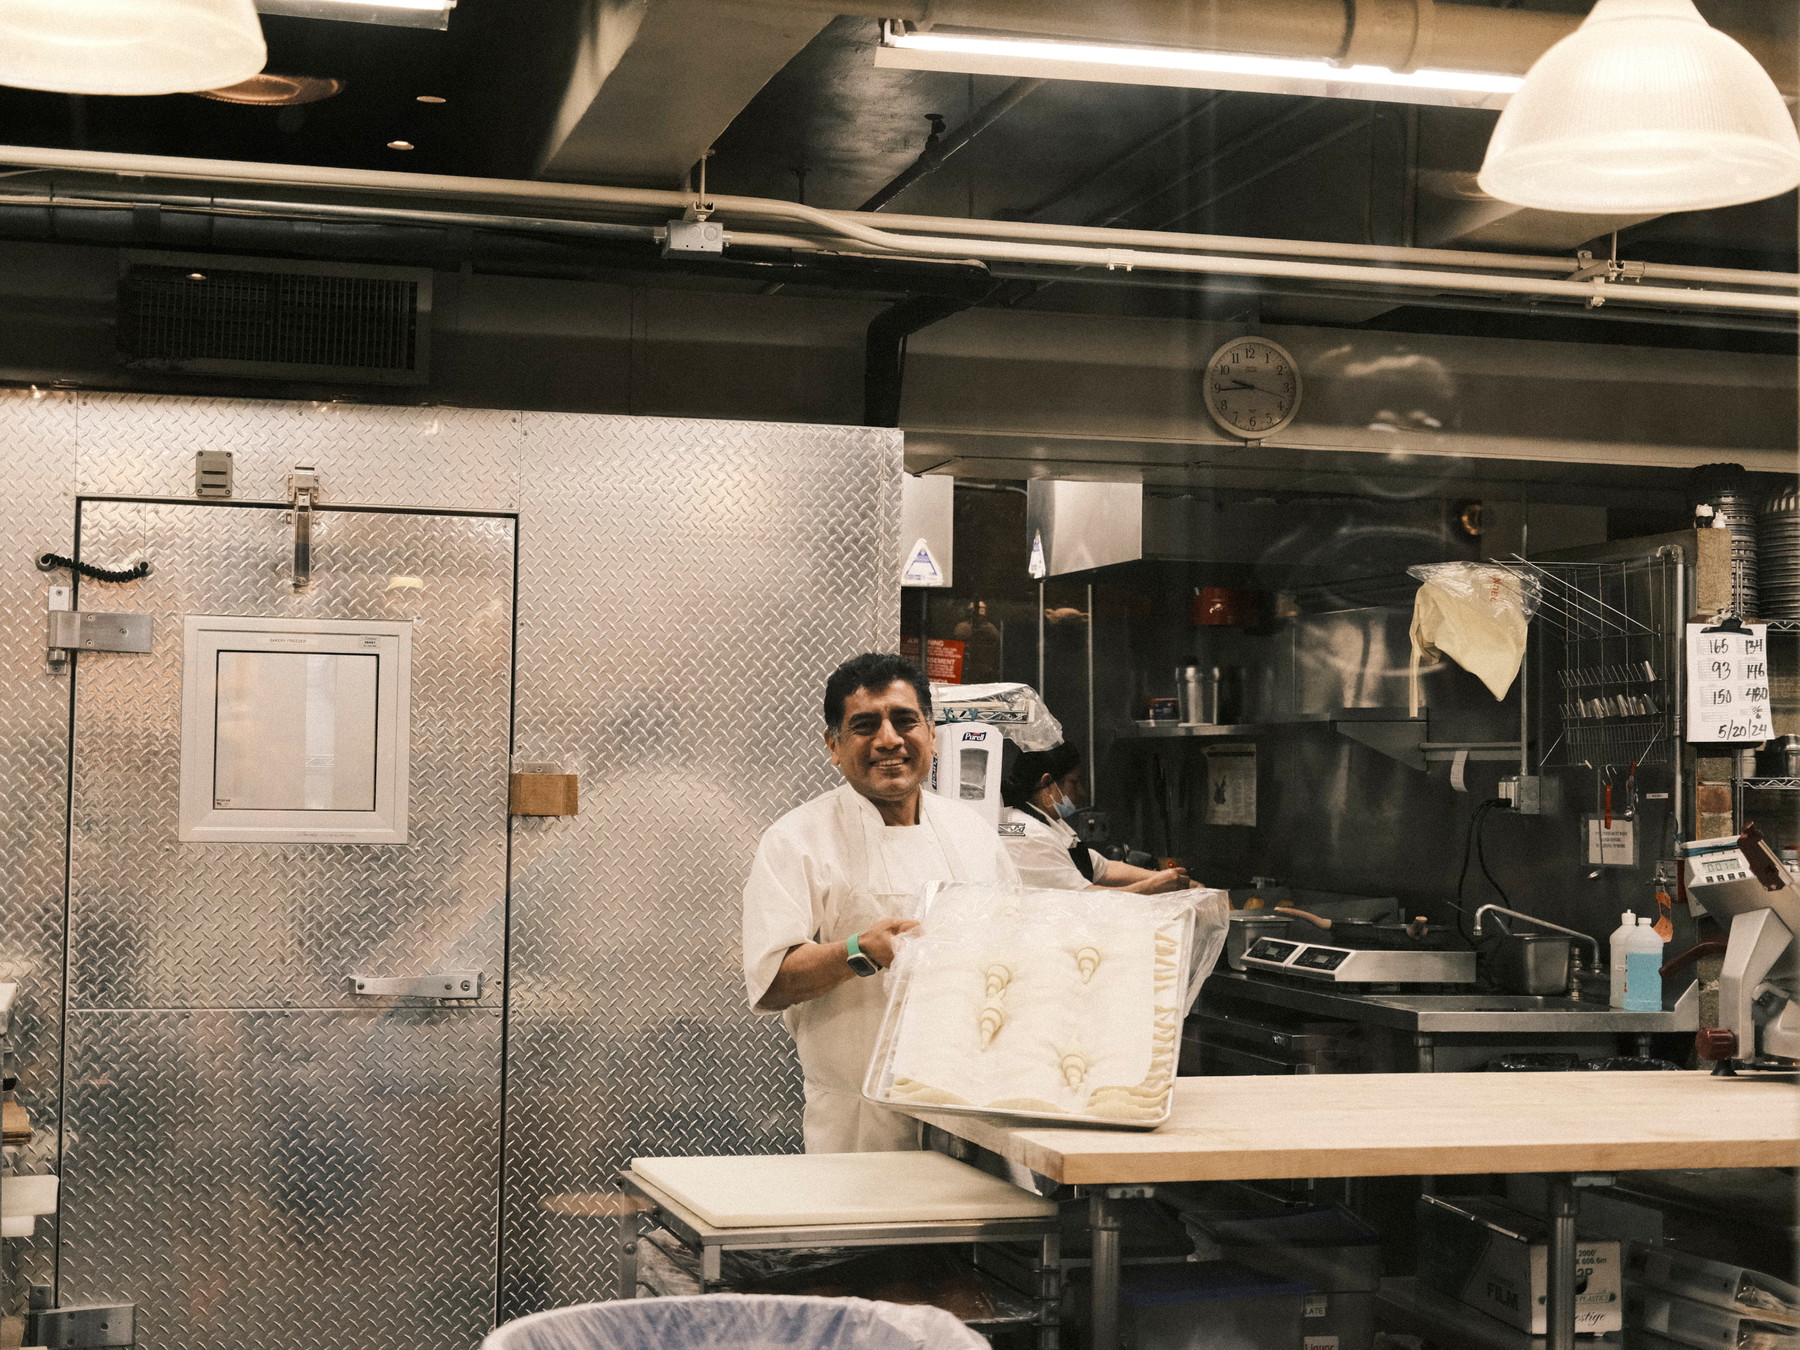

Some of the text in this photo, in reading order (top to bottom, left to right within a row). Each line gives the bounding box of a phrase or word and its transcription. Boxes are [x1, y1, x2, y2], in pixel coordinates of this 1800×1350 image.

[1232, 353, 1240, 364] 11
[1246, 348, 1255, 358] 12
[1265, 353, 1270, 364] 1
[1220, 365, 1230, 375] 10
[1276, 365, 1284, 376] 2
[1214, 384, 1221, 394] 9
[1284, 383, 1290, 393] 3
[1220, 400, 1228, 410] 8
[1277, 400, 1284, 410] 4
[1233, 412, 1239, 422] 7
[1250, 416, 1256, 426] 6
[1266, 413, 1272, 424] 5
[1709, 639, 1729, 654] 165
[1745, 638, 1764, 654] 134
[1712, 661, 1732, 680] 93
[1746, 664, 1765, 680] 146
[1713, 690, 1732, 705] 150
[1718, 719, 1768, 740] 5/20/24
[965, 733, 985, 741] Purell
[1487, 1282, 1519, 1312] FILM
[1576, 1311, 1606, 1326] estige
